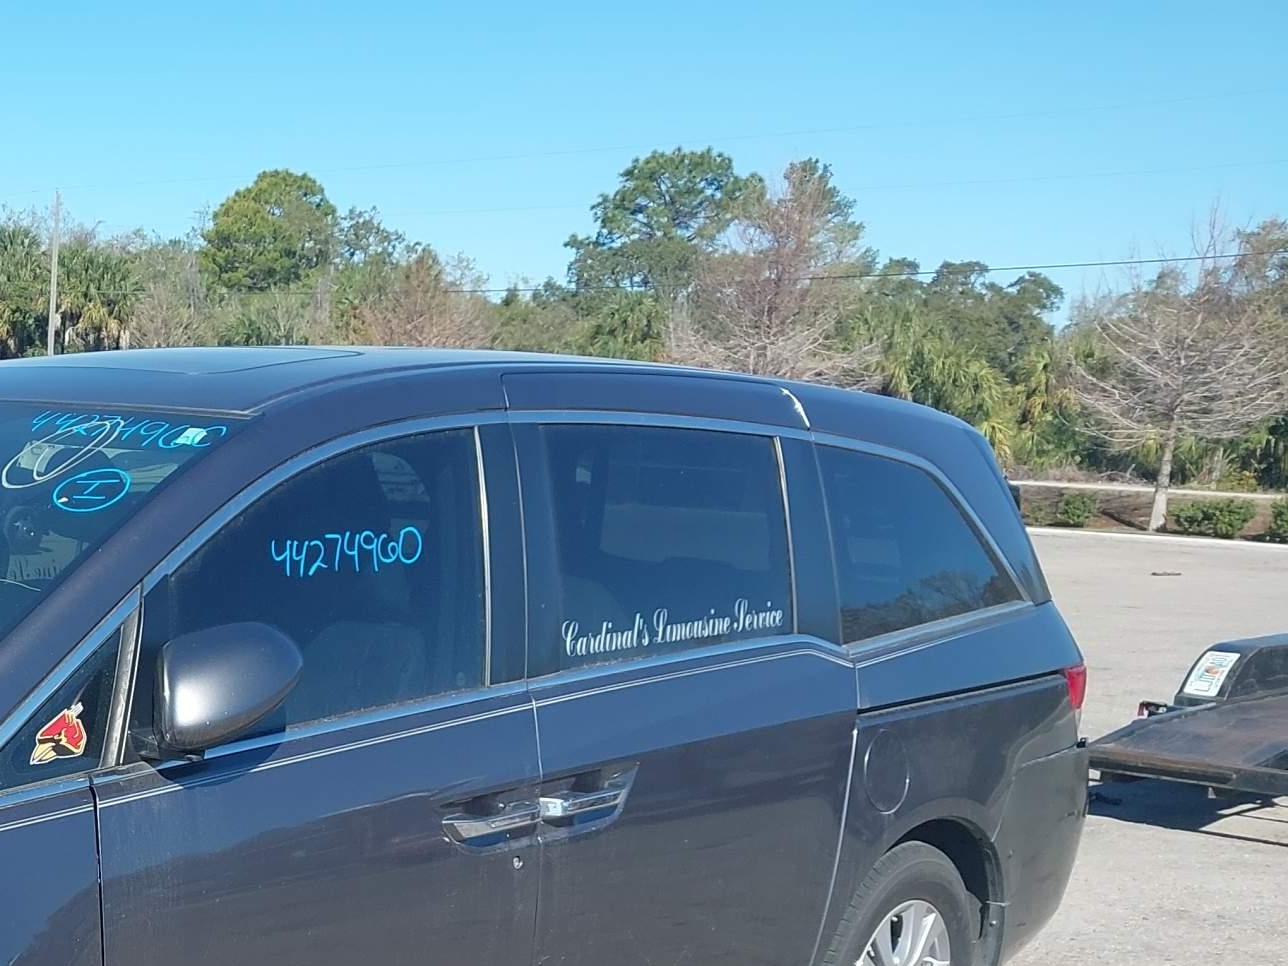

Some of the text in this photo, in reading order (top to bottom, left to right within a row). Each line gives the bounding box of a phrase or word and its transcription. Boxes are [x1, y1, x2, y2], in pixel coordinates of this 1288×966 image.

[271, 526, 423, 577] 44274960
[561, 598, 784, 657] Cardinal's Limousine Service
